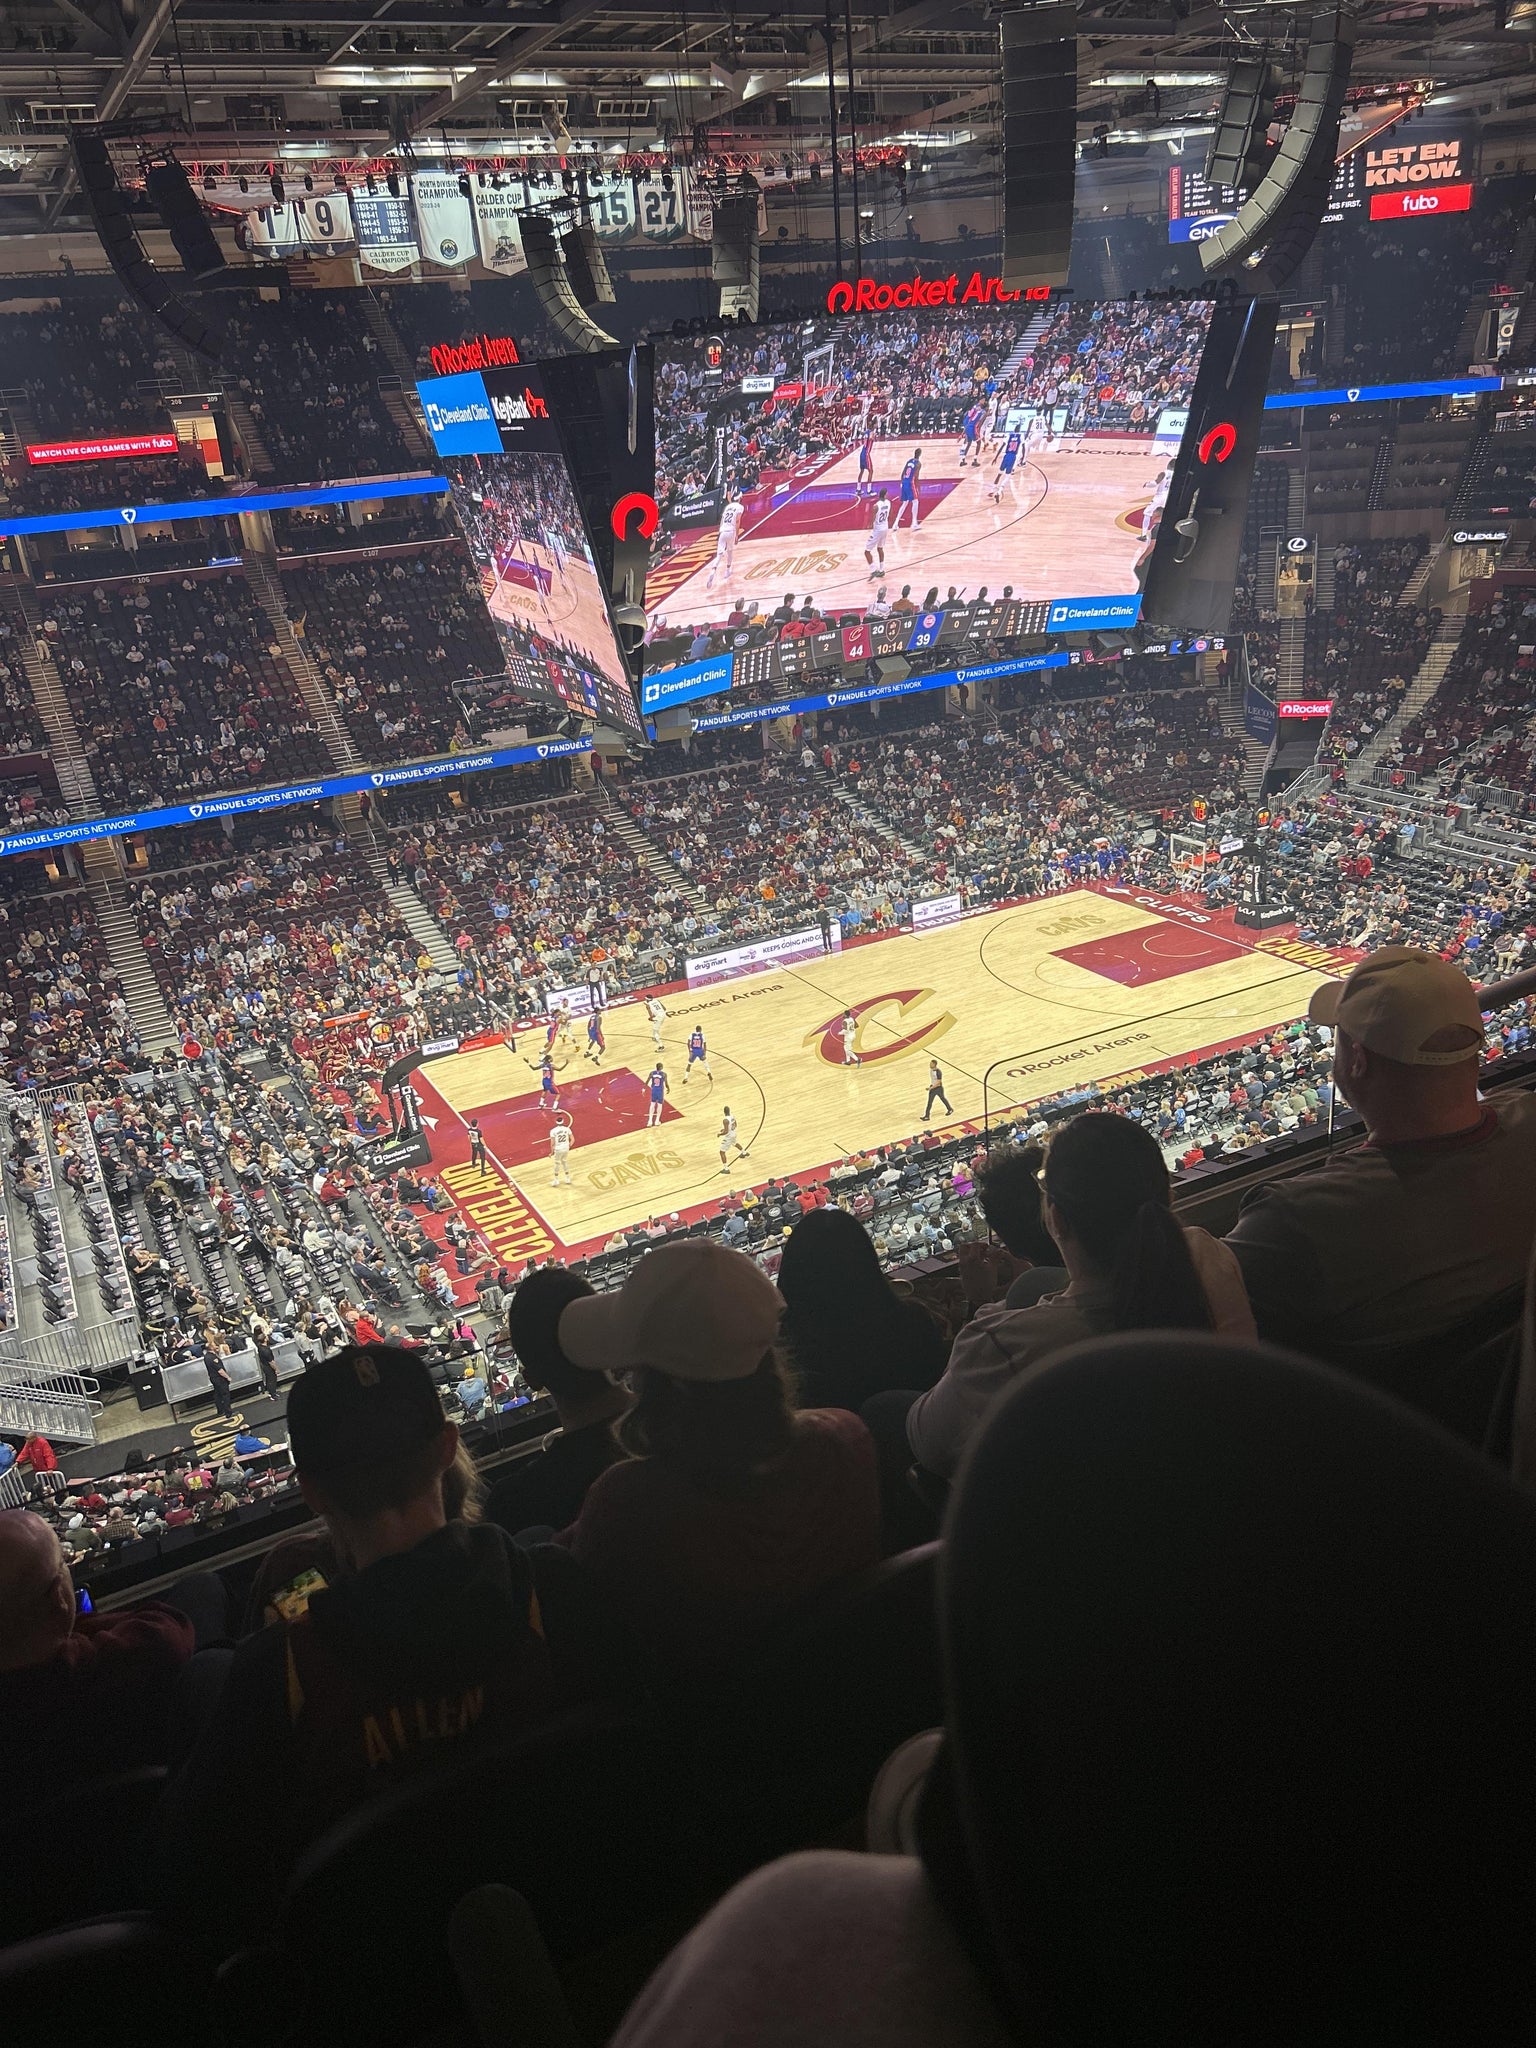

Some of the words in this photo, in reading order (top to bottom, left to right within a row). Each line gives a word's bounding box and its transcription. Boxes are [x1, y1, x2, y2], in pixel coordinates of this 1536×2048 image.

[1366, 146, 1417, 167] LET
[1419, 141, 1460, 161] EM
[1366, 160, 1461, 187] KNOW.
[476, 194, 504, 205] CALDER
[507, 192, 522, 204] CUP
[598, 192, 629, 226] 15
[644, 192, 676, 226] 27
[1402, 194, 1438, 212] fubo
[314, 200, 334, 236] 9
[856, 273, 960, 311] Rocket
[441, 336, 487, 372] Rocket
[484, 334, 520, 366] Arena
[440, 405, 474, 424] Cleveland
[472, 404, 491, 421] Clinic
[490, 395, 531, 424] KeyBank
[32, 449, 61, 459] WATCH
[62, 447, 79, 456] LIVE
[80, 446, 101, 455] CAVS
[102, 443, 130, 453] GAMES
[131, 442, 150, 451] WITH
[152, 438, 173, 449] fubo
[724, 512, 733, 523] 22
[878, 511, 888, 522] 20
[1468, 532, 1507, 541] LEXUS
[744, 550, 848, 581] CAVS
[510, 594, 538, 612] CAVS
[1068, 606, 1108, 619] Cleveland
[1110, 605, 1133, 616] Clinic
[872, 624, 884, 634] 2Q
[877, 641, 903, 654] 10:14
[916, 634, 930, 646] 39
[849, 644, 864, 658] 44
[966, 668, 994, 678] FANDUEL
[994, 664, 1016, 674] SPORTS
[1017, 659, 1046, 670] NETWORK
[661, 675, 701, 694] Cleveland
[703, 669, 726, 682] Clinic
[838, 691, 867, 702] FANDUEL
[868, 687, 892, 697] SPORTS
[892, 681, 922, 692] NETWORK
[700, 716, 732, 726] FANDUEL
[732, 711, 757, 721] SPORTS
[759, 705, 790, 716] NETWORK
[1292, 704, 1331, 714] Rocket
[549, 743, 576, 755] FANDUEL
[384, 768, 423, 783] FANDUEL
[424, 763, 455, 778] SPORTS
[456, 756, 494, 772] NETWORK
[204, 800, 246, 814] FANDUEL
[247, 794, 280, 806] SPORTS
[281, 786, 323, 801] NETWORK
[7, 834, 53, 849] FANDUEL
[53, 826, 90, 841] SPORTS
[91, 818, 137, 834] NETWORK
[1135, 896, 1211, 923] CLIFFS
[1036, 915, 1106, 937] CAVS
[763, 944, 780, 953] KEEPS
[782, 939, 801, 949] GOING
[694, 962, 710, 970] drug
[711, 957, 727, 966] mart
[666, 996, 730, 1018] Rocket
[732, 984, 784, 1001] Arena
[1022, 1048, 1096, 1074] Rocket
[1094, 1032, 1151, 1053] Arena
[383, 1148, 406, 1159] Cleveland
[406, 1144, 420, 1152] Clinic
[588, 1150, 685, 1190] CAVS
[440, 1160, 555, 1262] CLEVELAND
